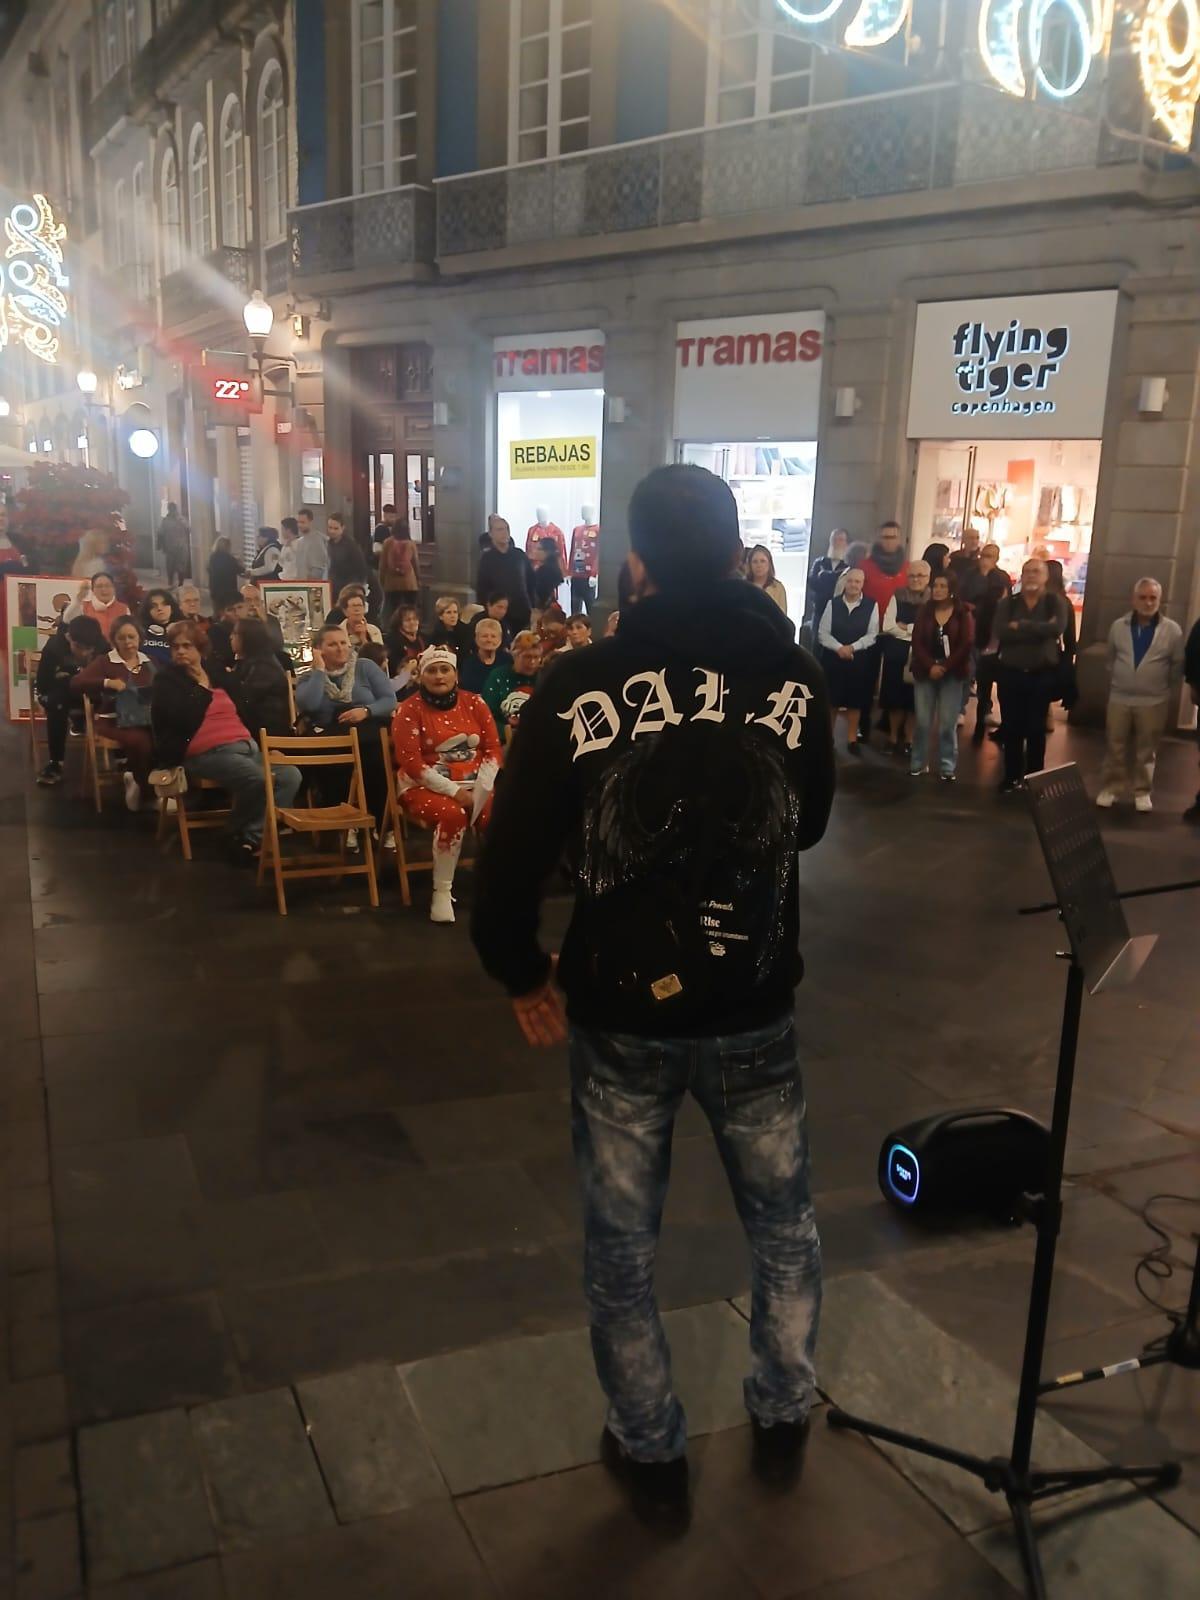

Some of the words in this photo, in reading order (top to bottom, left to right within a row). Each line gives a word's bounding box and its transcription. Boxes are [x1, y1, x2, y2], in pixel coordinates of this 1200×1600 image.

[953, 319, 1069, 362] flying
[955, 357, 1058, 398] tiger
[952, 399, 1055, 416] copenhagen
[514, 443, 591, 465] REBAJAS
